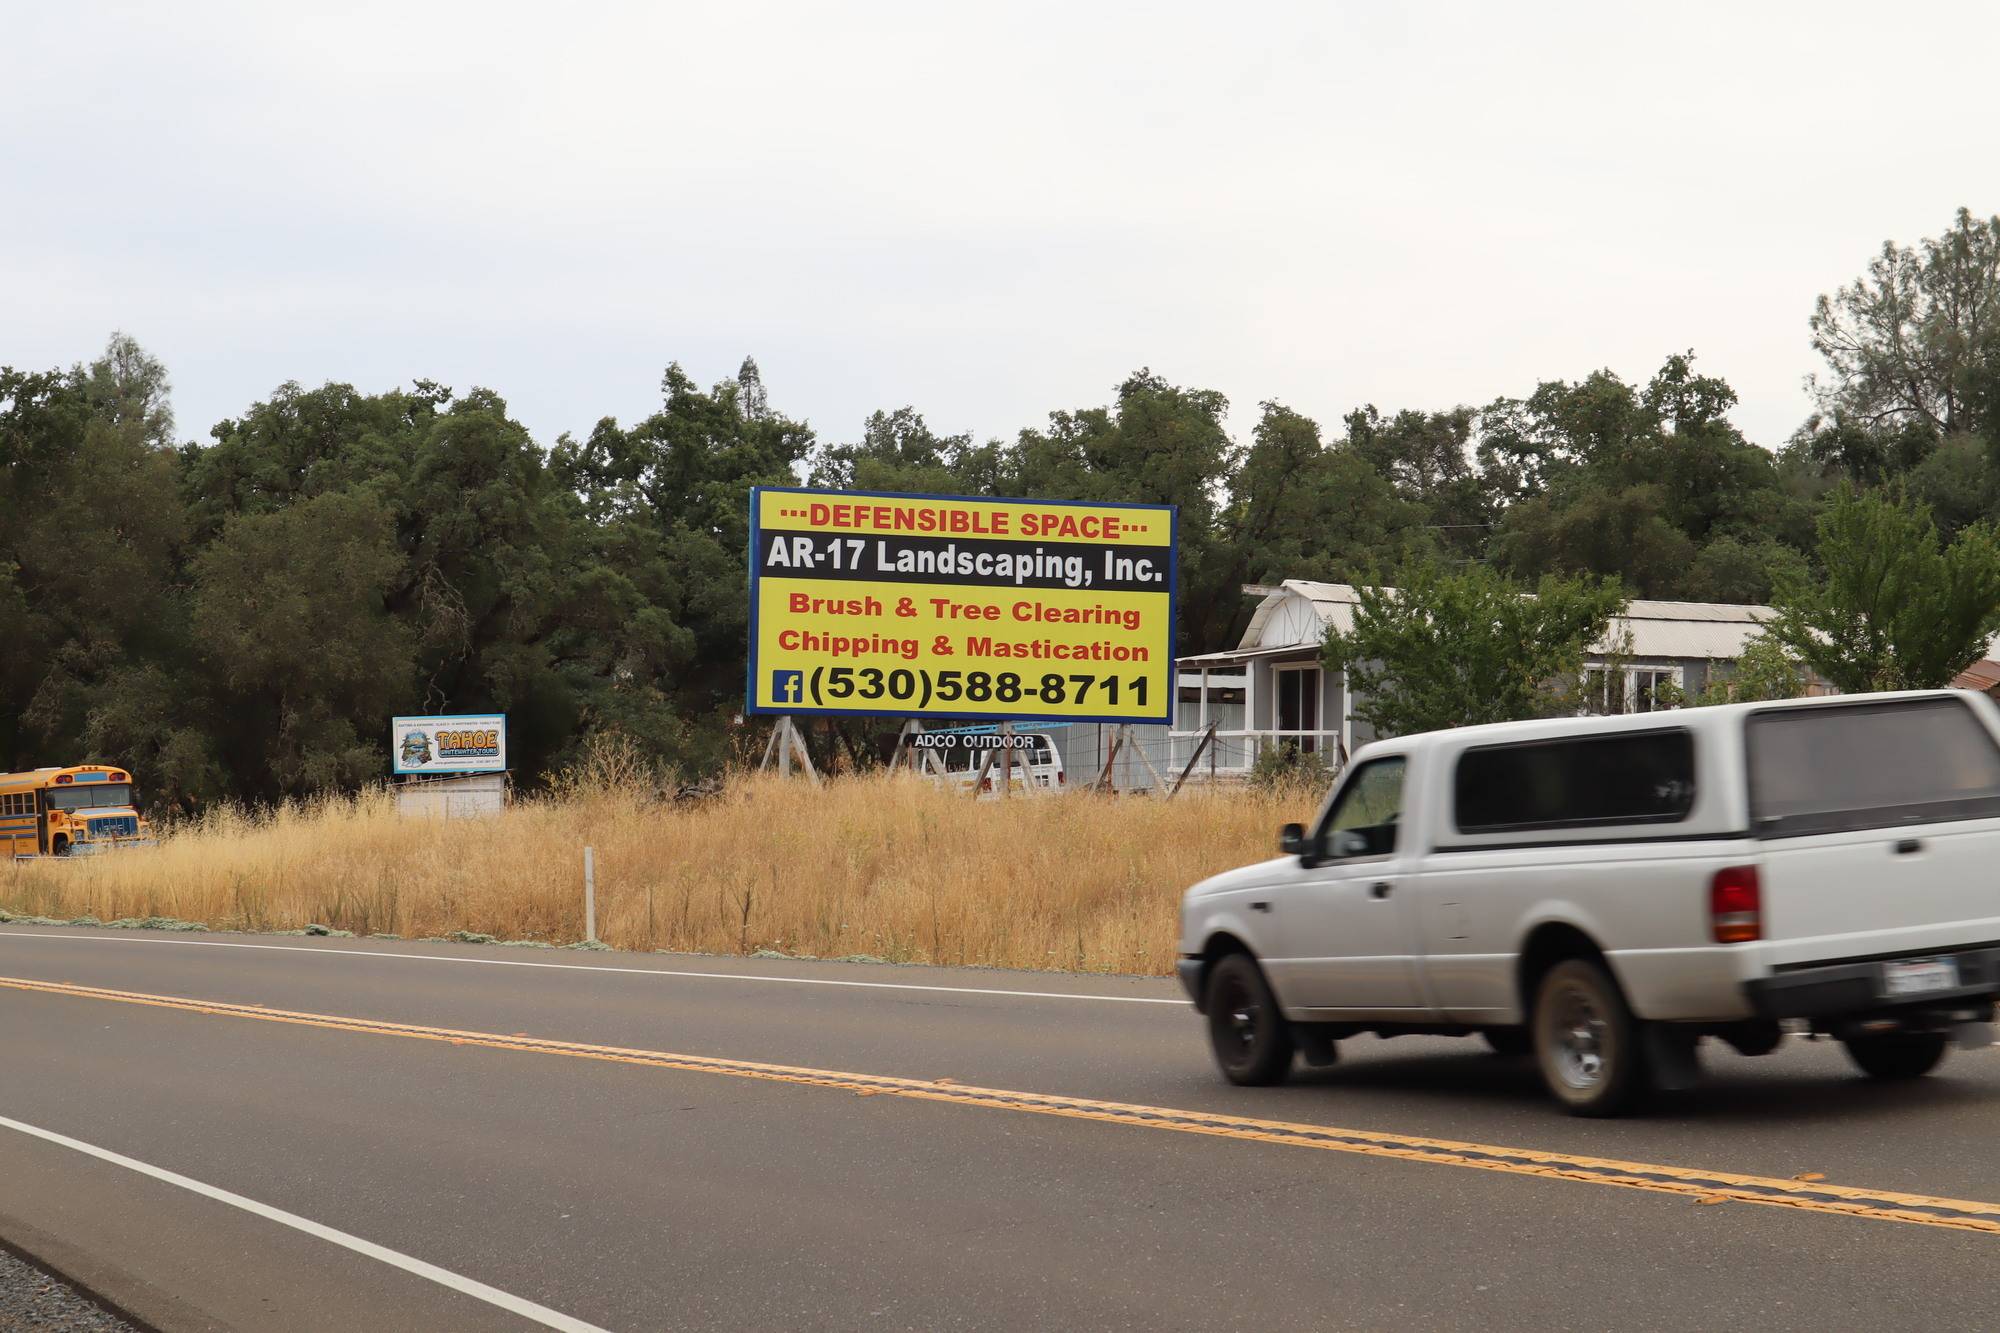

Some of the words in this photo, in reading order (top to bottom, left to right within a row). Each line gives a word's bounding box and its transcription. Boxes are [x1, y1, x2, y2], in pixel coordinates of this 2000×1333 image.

[767, 536, 865, 570] AR-17
[877, 540, 1092, 587] Landscaping,
[1105, 550, 1163, 581] Inc.
[789, 593, 882, 617] Brush
[895, 597, 918, 617] &
[930, 598, 1001, 620] Tree
[1012, 602, 1141, 629] Clearing
[779, 630, 919, 659] Chipping
[932, 636, 954, 656] &
[967, 637, 1149, 661] Mastication
[810, 666, 1148, 708] (530)588-8711
[437, 731, 498, 749] TAHOE
[915, 735, 956, 747] ADCO
[963, 735, 1034, 748] OUTDOOR
